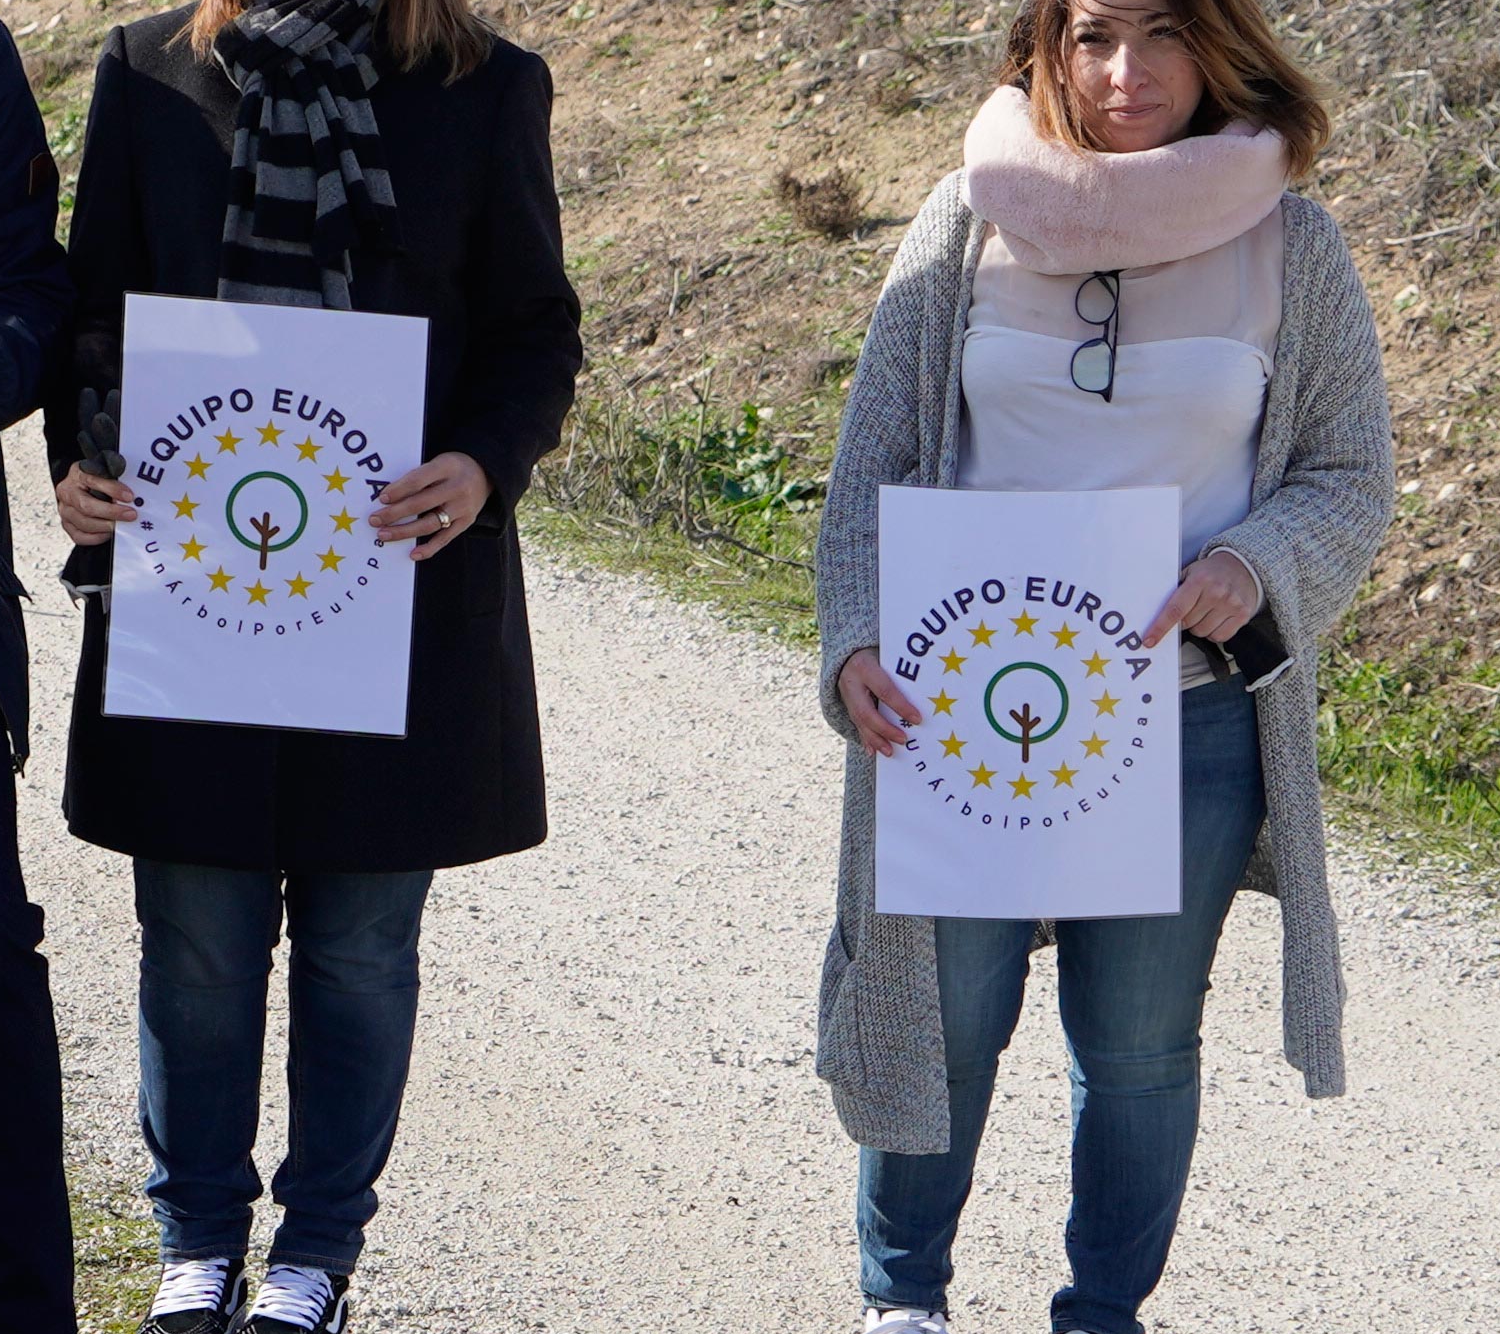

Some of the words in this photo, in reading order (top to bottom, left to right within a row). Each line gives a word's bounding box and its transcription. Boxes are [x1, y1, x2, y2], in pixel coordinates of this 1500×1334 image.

[138, 388, 254, 486] EQUIPO
[272, 388, 391, 502] EUROPA
[895, 578, 1007, 683] EQUIPO
[1024, 576, 1153, 681] EUROPA
